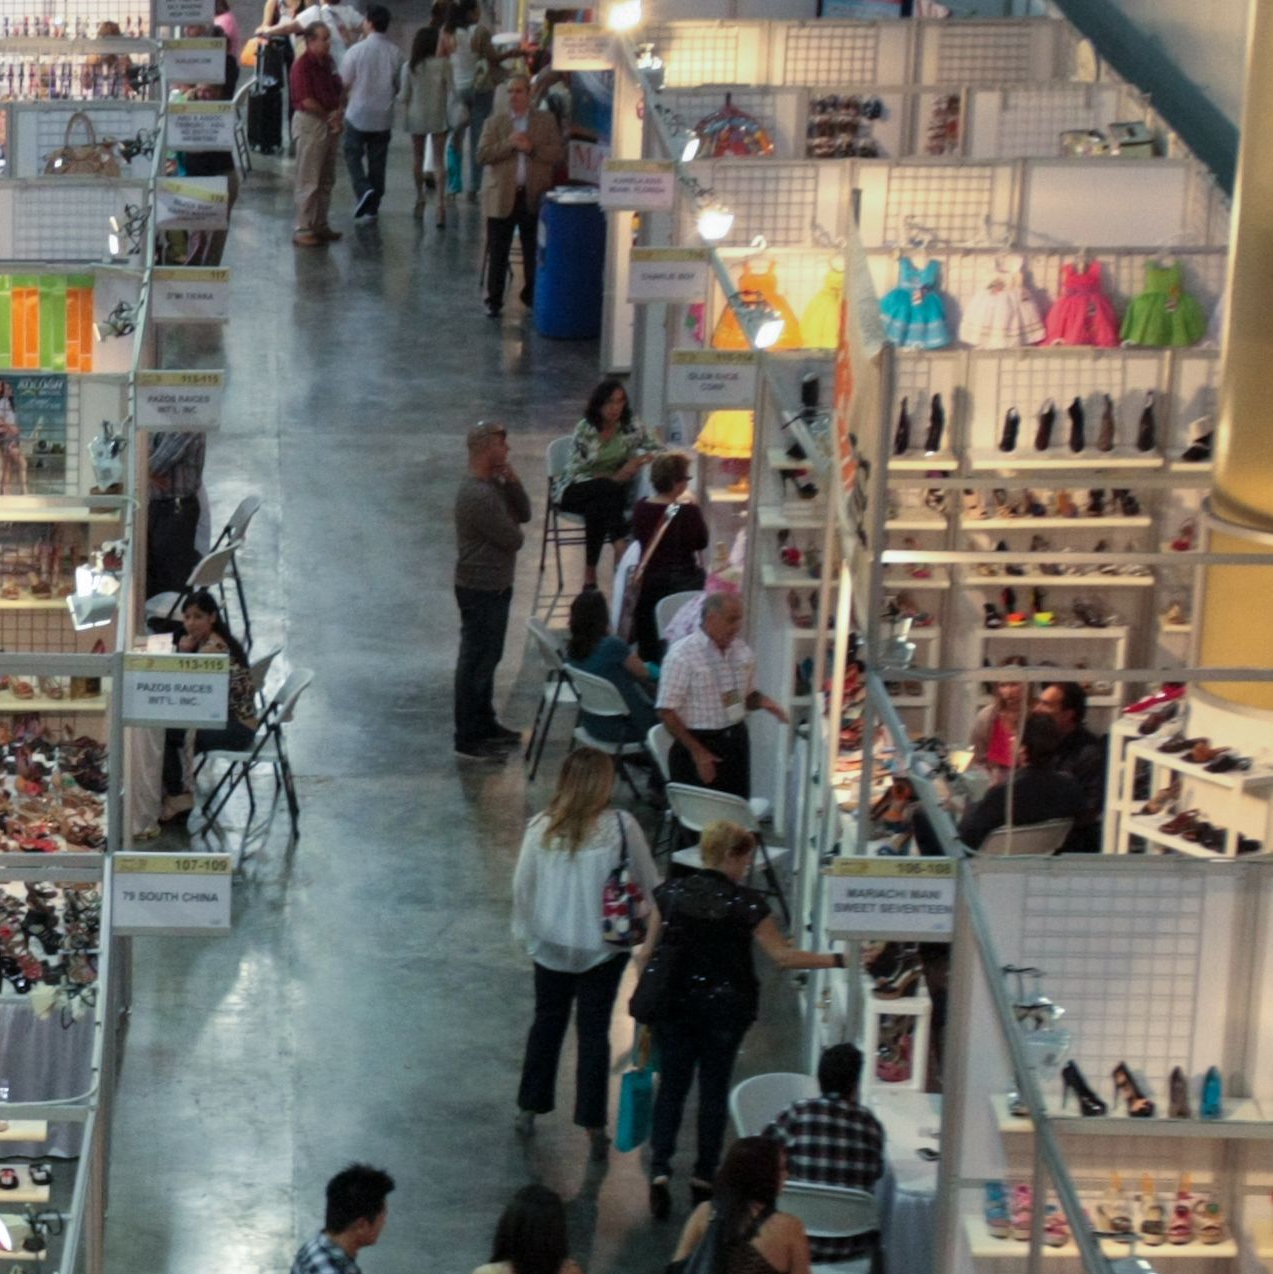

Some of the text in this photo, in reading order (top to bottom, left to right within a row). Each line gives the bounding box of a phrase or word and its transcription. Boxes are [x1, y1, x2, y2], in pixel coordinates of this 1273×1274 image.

[178, 659, 224, 670] 113-115
[136, 682, 213, 693] PAZOS RAICES
[175, 859, 228, 872] 107-109
[138, 890, 180, 902] SOUTH
[181, 891, 220, 902] CHINA
[833, 903, 953, 914] SWEET SEVENTEEN
